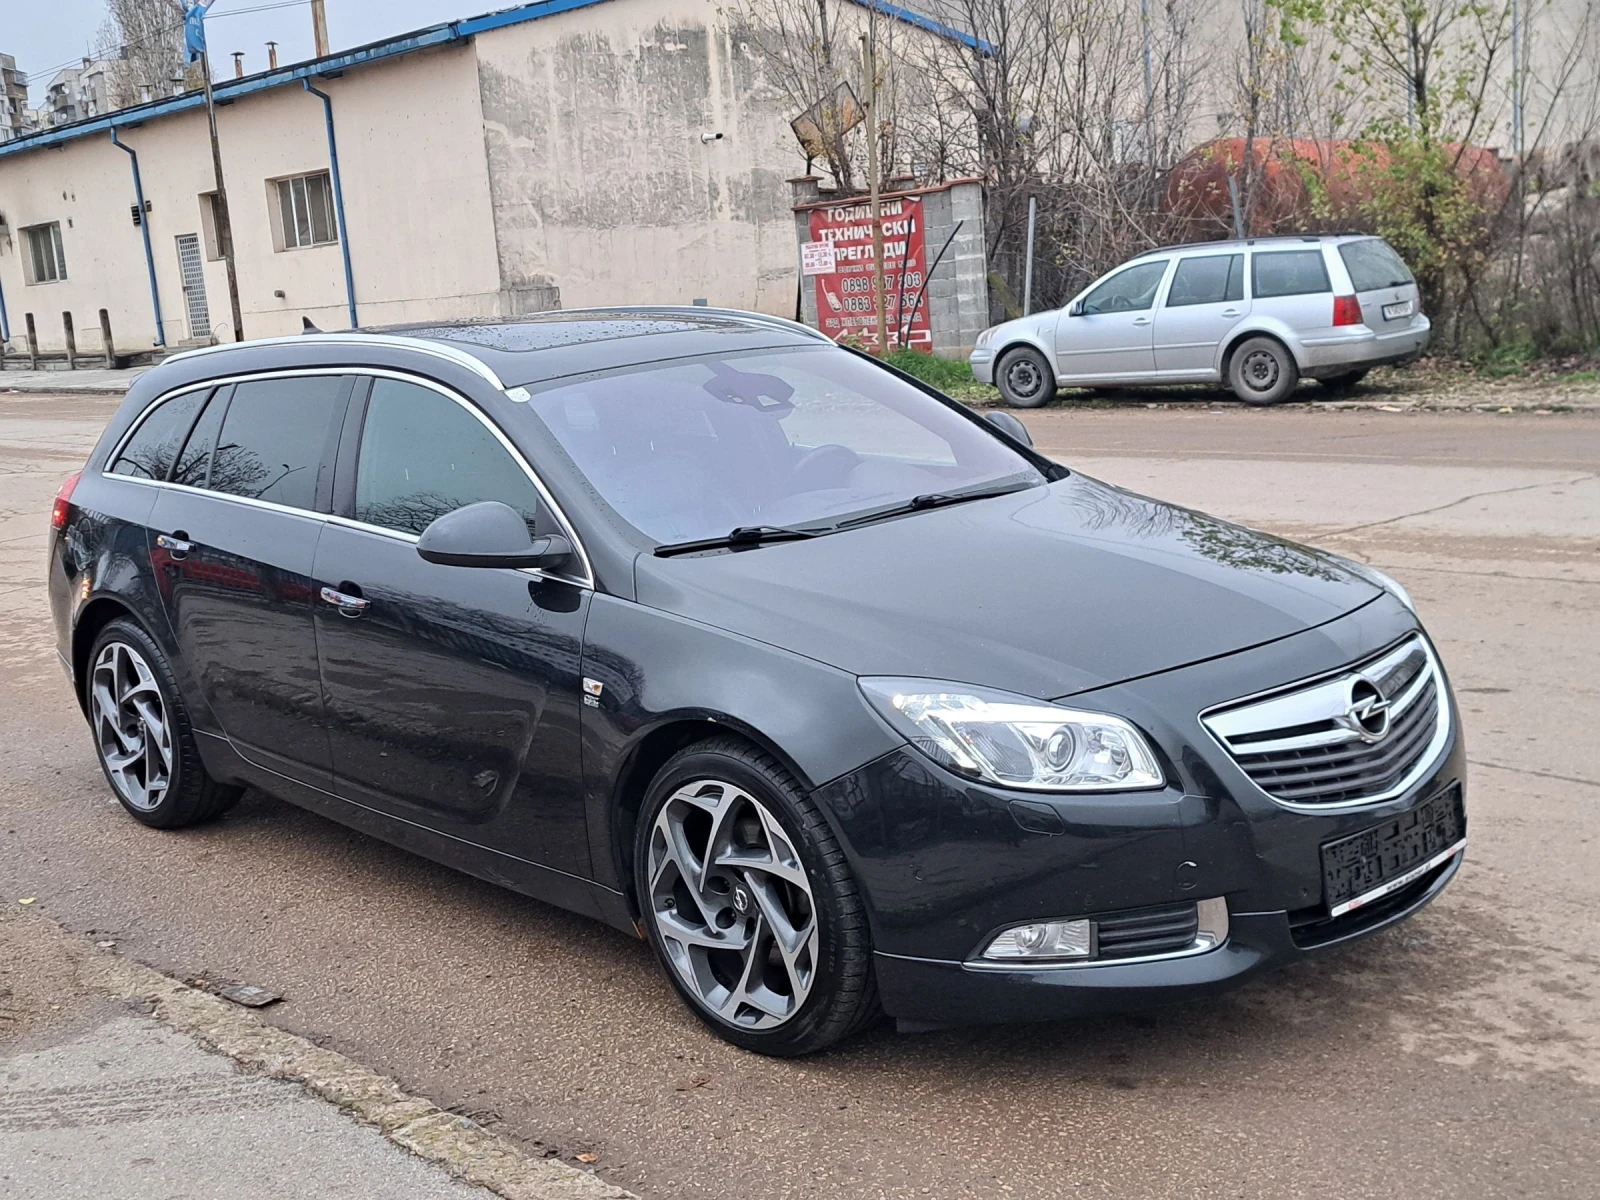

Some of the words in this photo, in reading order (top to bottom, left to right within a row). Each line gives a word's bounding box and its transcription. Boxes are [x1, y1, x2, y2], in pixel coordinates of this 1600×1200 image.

[819, 218, 916, 242] ТЕХНИЧСКИ
[834, 241, 906, 261] ПРЕГЛДИ
[842, 277, 869, 293] 0898
[843, 296, 871, 312] 0883
